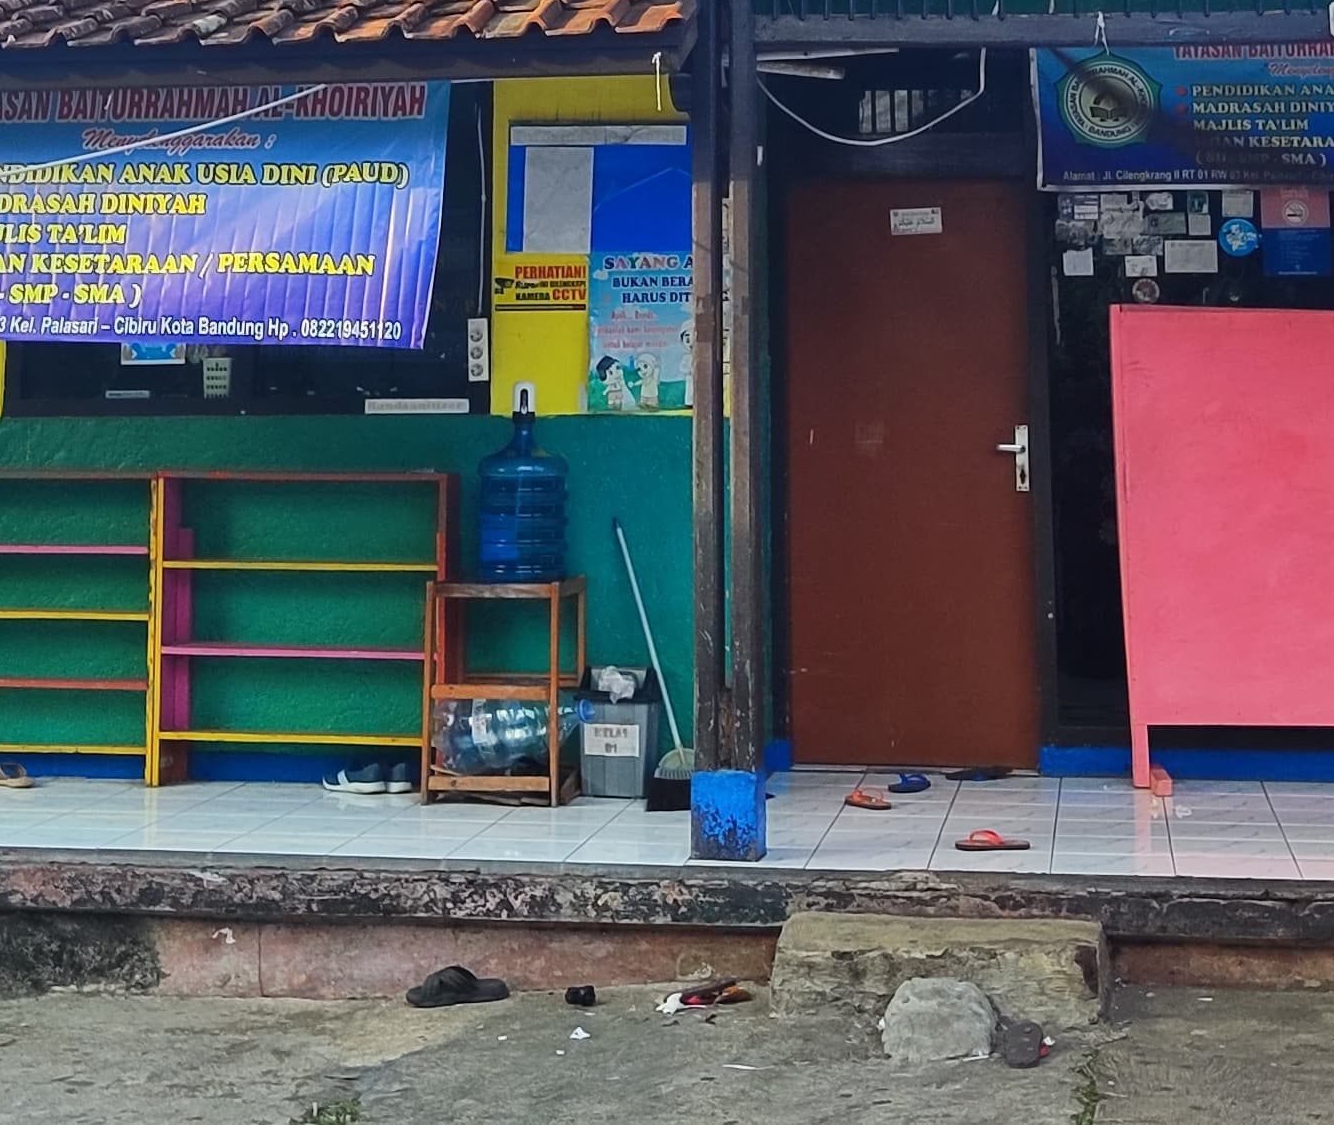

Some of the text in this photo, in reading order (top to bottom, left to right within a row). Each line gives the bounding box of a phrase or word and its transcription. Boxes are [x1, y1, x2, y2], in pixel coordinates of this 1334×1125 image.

[1192, 84, 1299, 97] PENDIDIKAN
[56, 85, 249, 123] BAITURRAHMAH
[252, 82, 427, 120] AL-KHOIRIYAH
[1192, 102, 1286, 114] MADRASAH
[1193, 119, 1309, 131] MAJLIS TA'LIM
[82, 127, 260, 155] Menyelenggarakan
[1280, 153, 1316, 165] SMA
[119, 163, 191, 185] ANAK
[197, 163, 257, 185] USIA
[260, 162, 318, 185] DINI
[322, 162, 410, 190] (PAUD)
[1063, 171, 1095, 181] Alamat
[1116, 170, 1172, 183] Cilengkrang
[1182, 170, 1196, 179] RT
[1198, 169, 1208, 179] 01
[101, 193, 207, 215] DINIYAH
[46, 223, 127, 245] TA'LIM
[29, 253, 199, 275] KESETARAAN
[200, 253, 215, 279] /
[216, 251, 377, 277] PERSAMAAN
[604, 256, 692, 270] SAYANG A
[514, 266, 586, 279] PERHATIAN!
[612, 276, 693, 288] BUKAN BERA
[8, 283, 59, 305] SMP
[73, 283, 126, 304] SMA
[515, 288, 587, 301] KAMERA CCTV
[622, 291, 692, 304] HARUS DIT
[10, 316, 36, 334] Kel.
[41, 316, 99, 335] Palasari
[114, 316, 157, 335] Cibiru
[161, 317, 194, 335] Kota
[198, 317, 264, 340] Bandung
[268, 318, 289, 340] Hp
[301, 319, 403, 340] 082219451120
